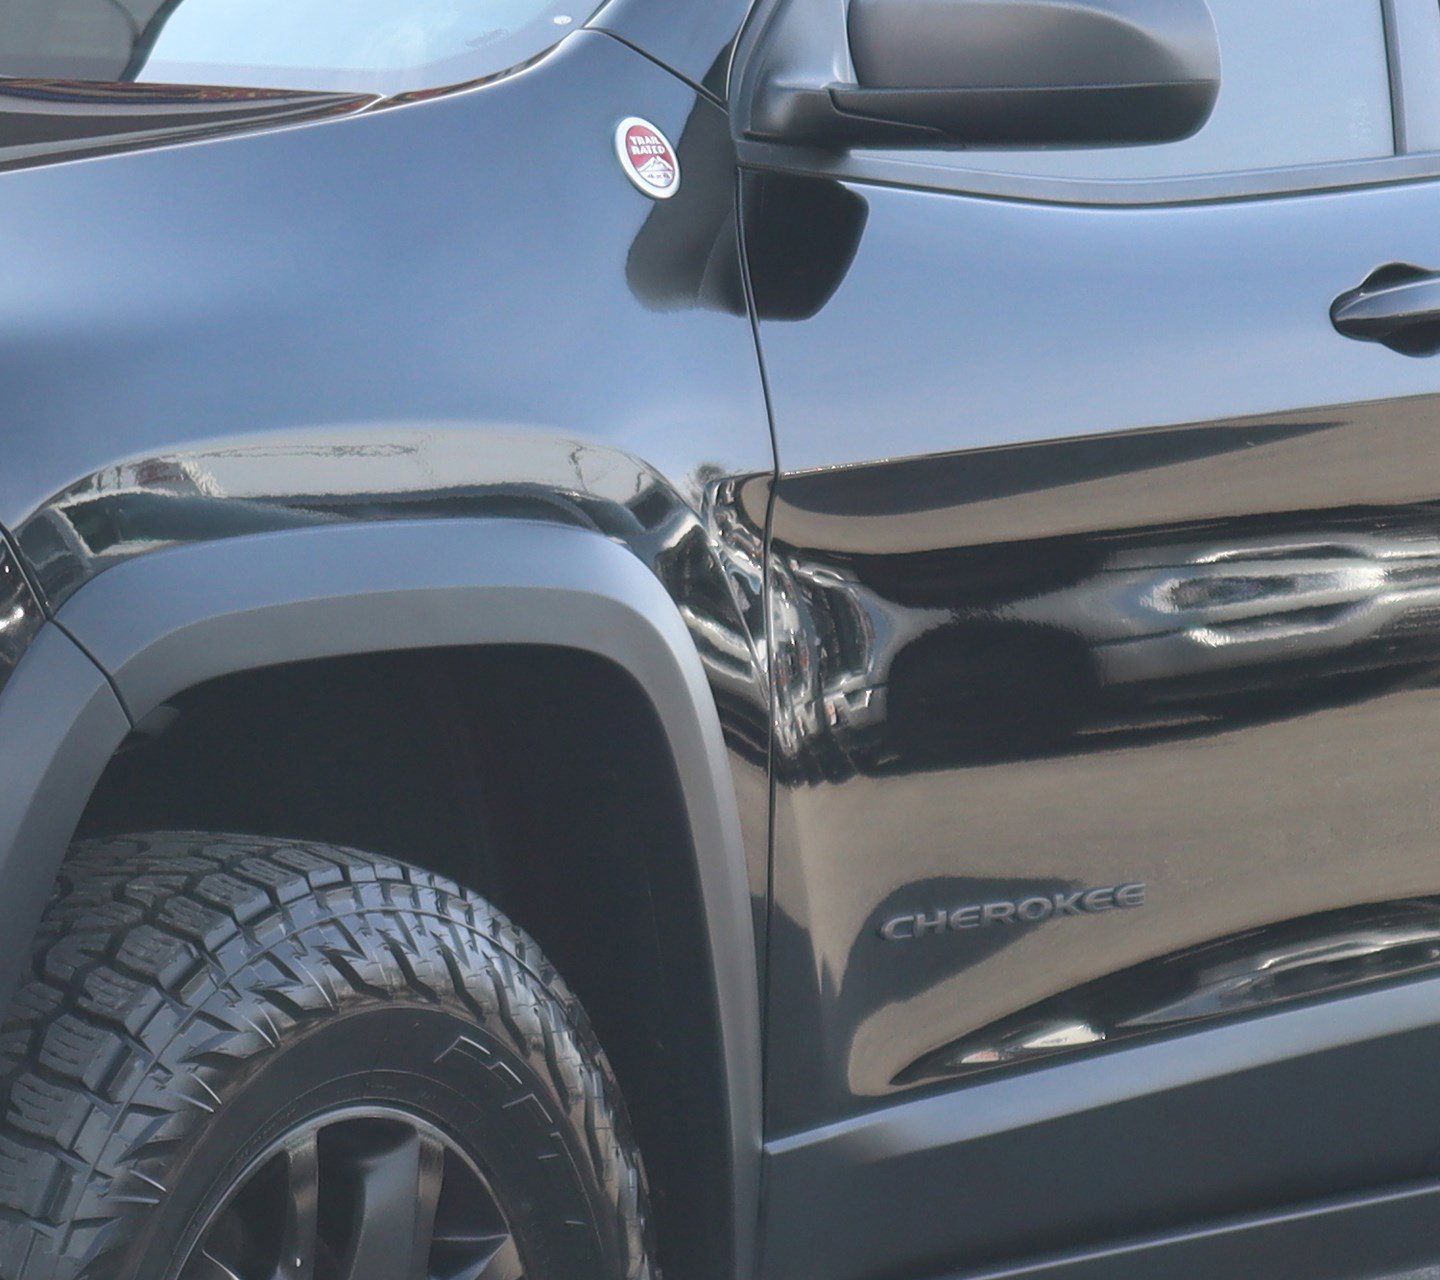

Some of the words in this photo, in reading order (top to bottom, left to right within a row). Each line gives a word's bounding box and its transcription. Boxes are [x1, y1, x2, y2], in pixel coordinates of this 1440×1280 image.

[629, 135, 661, 146] TRAIL
[631, 145, 666, 156] RATED
[879, 881, 1146, 941] CHEROKEE
